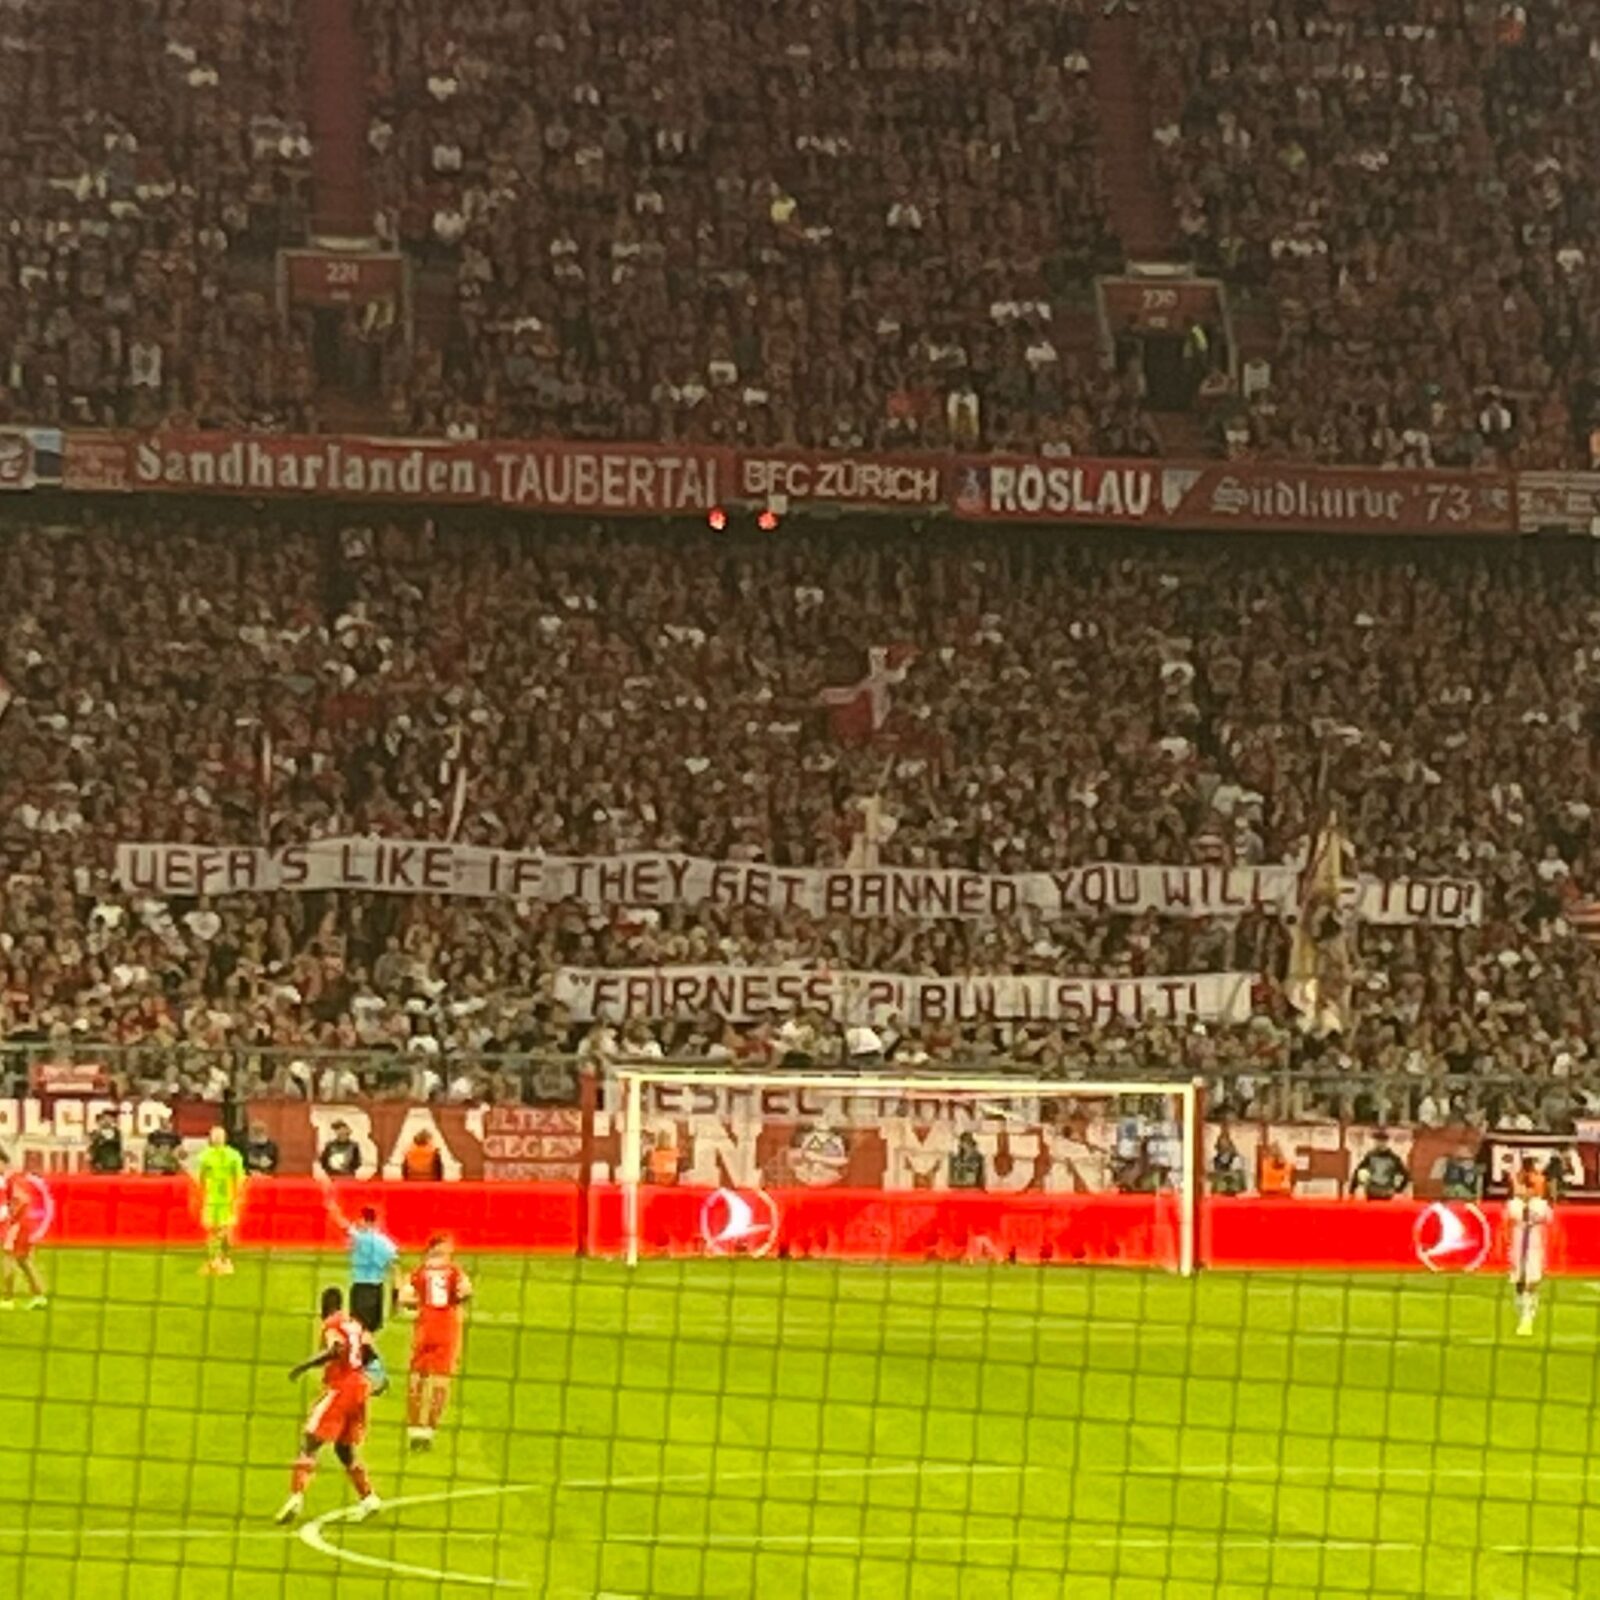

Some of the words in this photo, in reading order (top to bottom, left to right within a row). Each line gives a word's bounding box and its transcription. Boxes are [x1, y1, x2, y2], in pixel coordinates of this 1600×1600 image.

[489, 854, 543, 894] IF
[567, 858, 690, 899] THEY
[711, 864, 804, 914] GET
[1052, 866, 1139, 910] YOU
